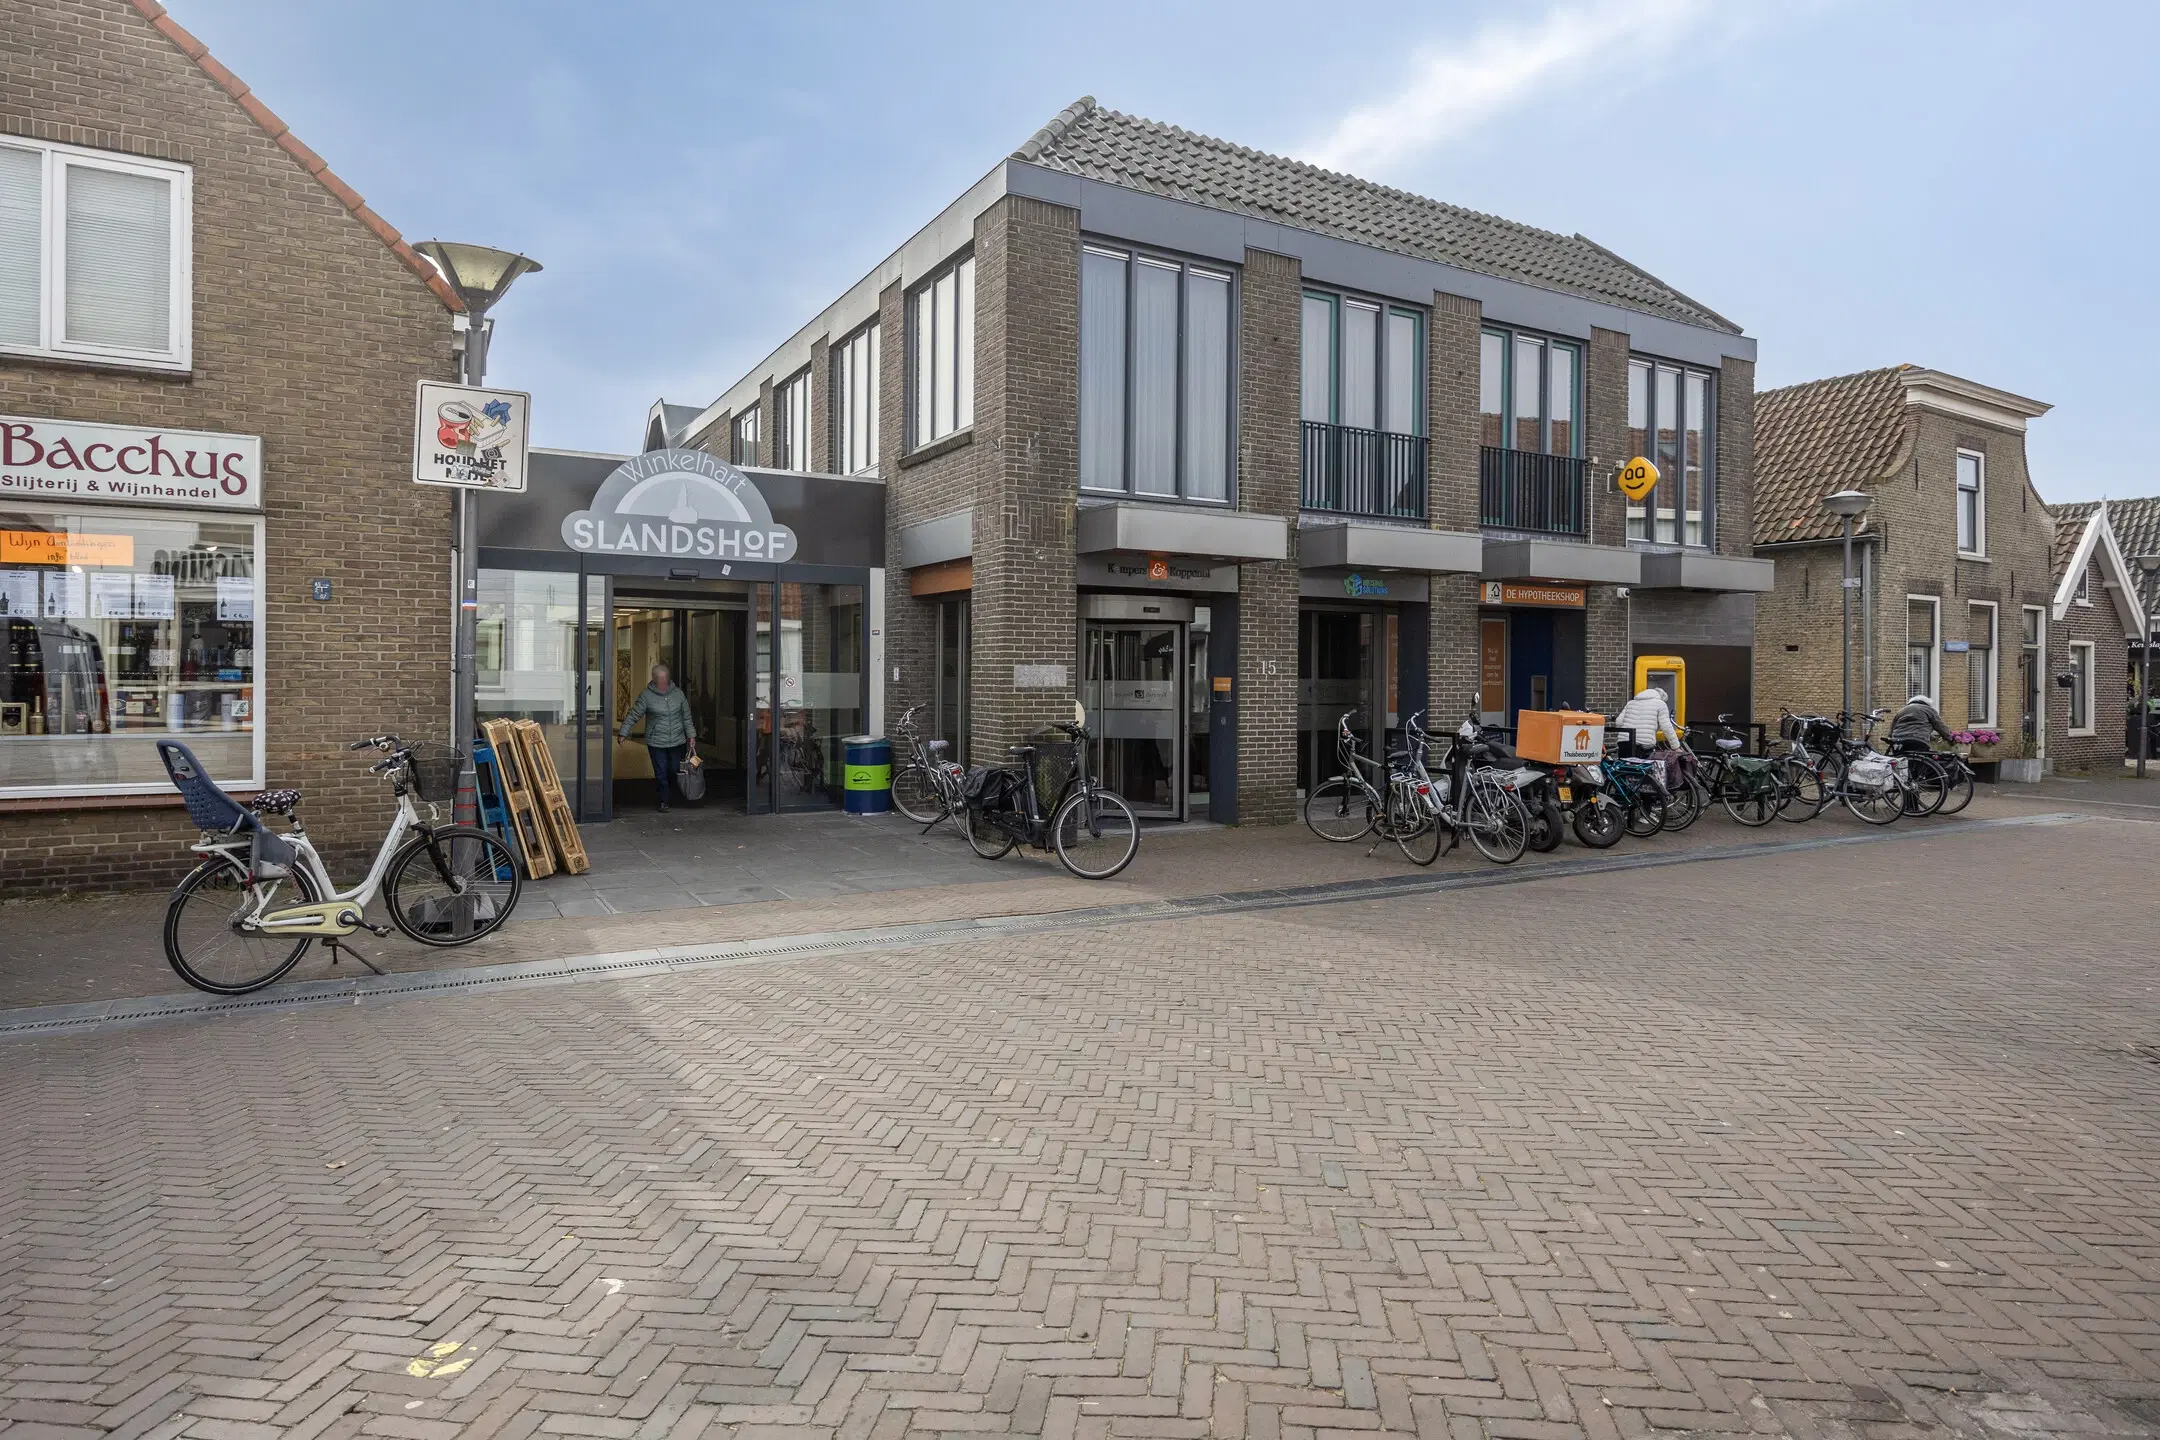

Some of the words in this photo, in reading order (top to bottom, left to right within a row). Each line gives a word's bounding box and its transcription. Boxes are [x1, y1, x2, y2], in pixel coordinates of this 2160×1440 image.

[0, 422, 248, 496] Bacchus
[618, 448, 748, 496] Winkelhart
[1, 475, 78, 492] Slijterij
[87, 480, 100, 492] &
[108, 481, 216, 499] Wijnhandel
[573, 518, 787, 559] SLANDSHOF
[1152, 562, 1166, 577] &
[1506, 588, 1517, 599] DE
[1519, 589, 1580, 602] HYPOTHEEKSHOP
[1261, 660, 1276, 675] 15
[1564, 751, 1598, 760] Thuisbezorgd.nl
